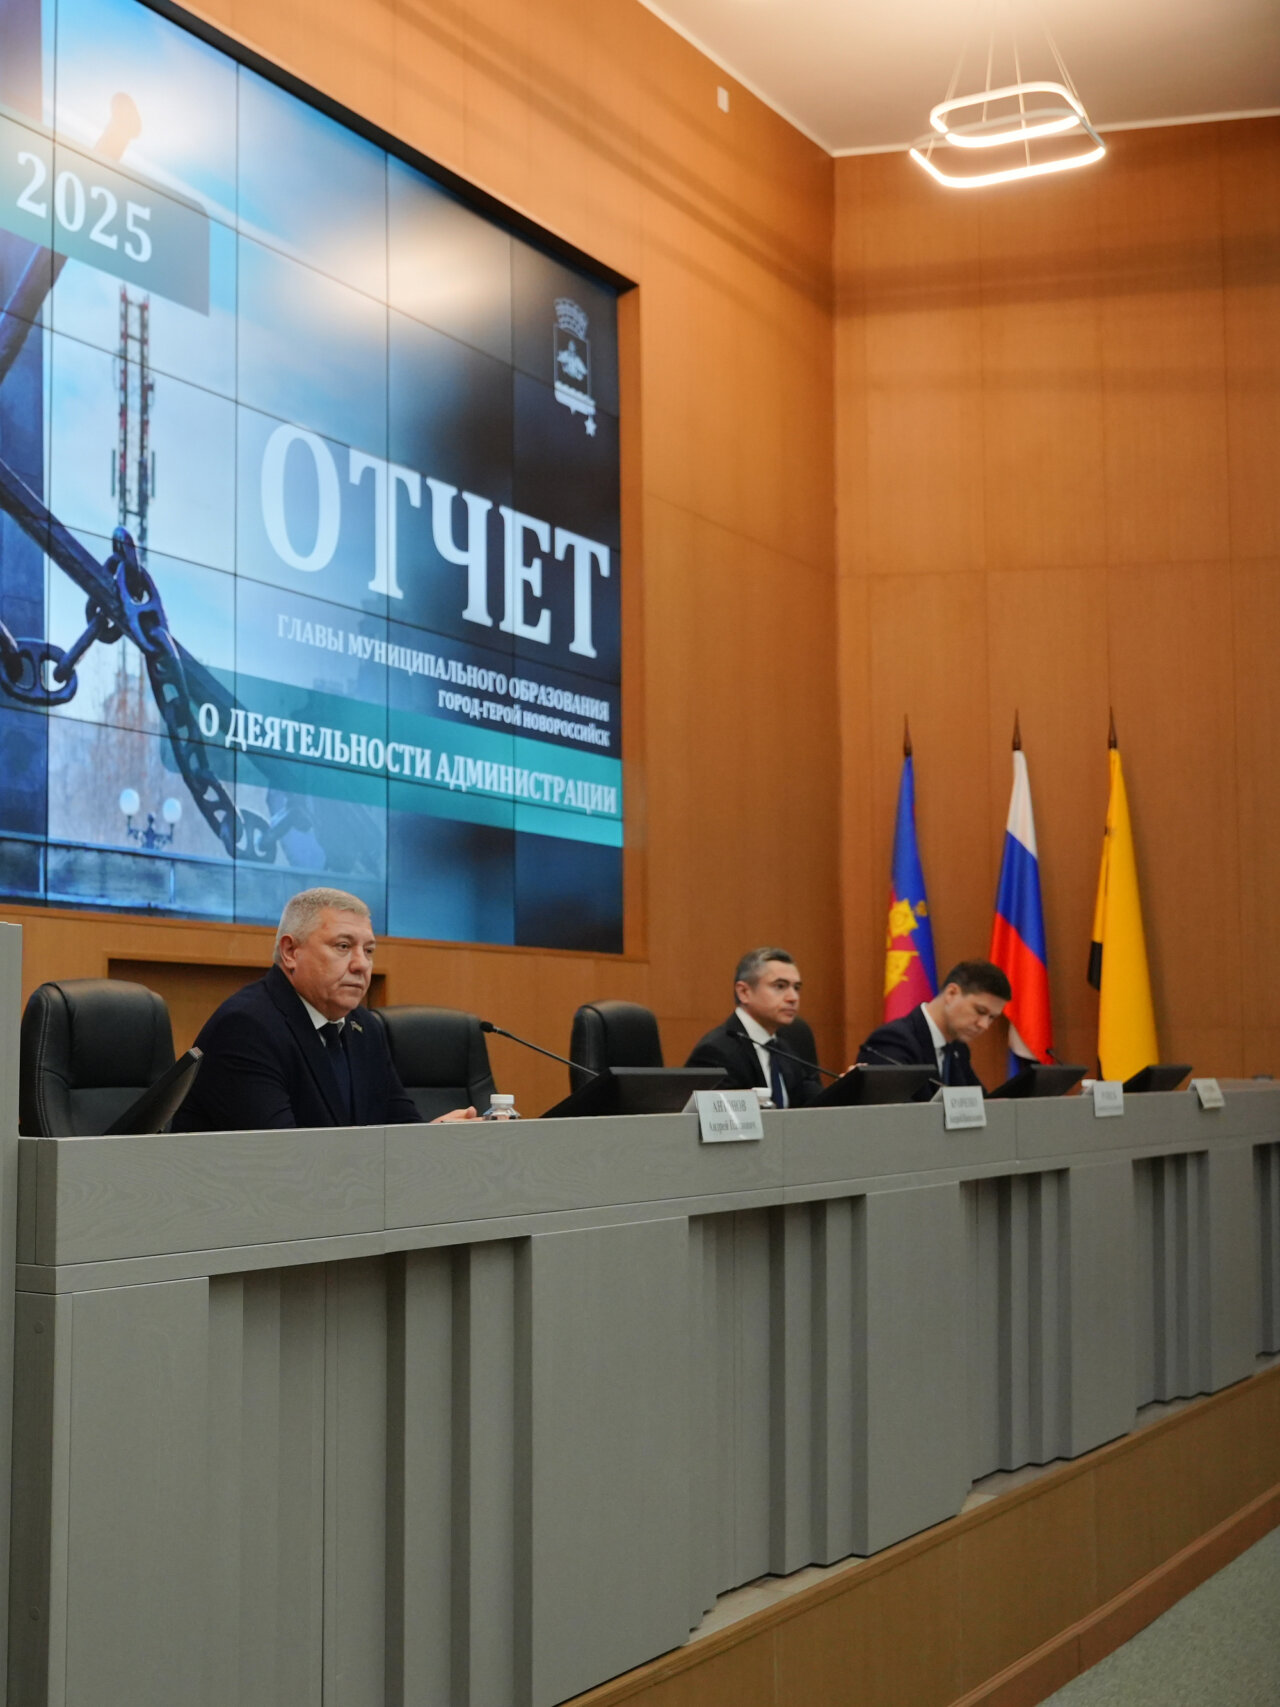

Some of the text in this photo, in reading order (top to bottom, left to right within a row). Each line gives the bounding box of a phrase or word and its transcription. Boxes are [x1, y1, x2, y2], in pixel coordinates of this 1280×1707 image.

[16, 151, 152, 263] 2025
[260, 422, 611, 659] ОТЧЕТ
[277, 614, 610, 722] ГЛАВЫ МУНИЦИПАЛЬНОГО ОБРАЗОВАНИЯ
[438, 689, 611, 747] ГОРОД-ГЕРОЙ НОВОРОССИЙСК
[198, 702, 617, 815] О ДЕЯТЕЛЬНОСТИ АДМИНИСТРАЦИИ
